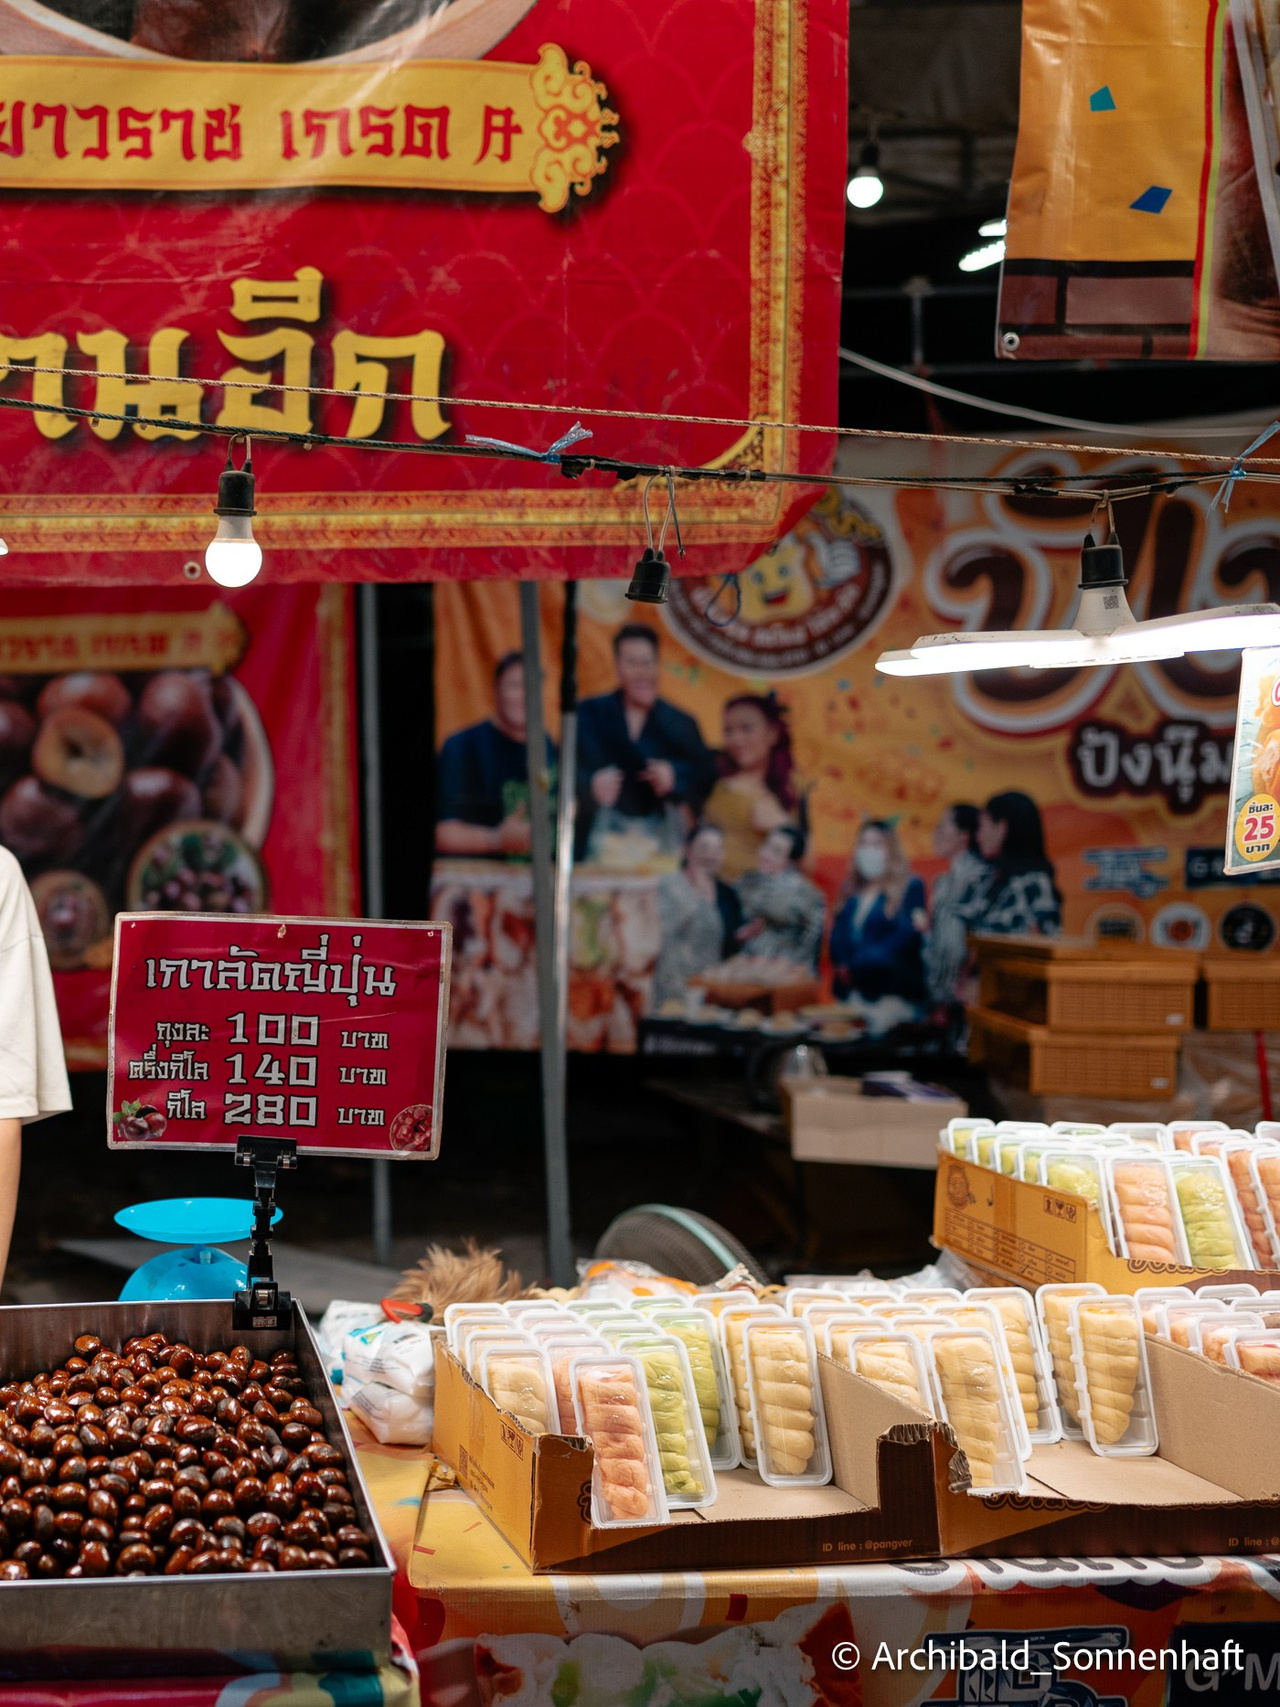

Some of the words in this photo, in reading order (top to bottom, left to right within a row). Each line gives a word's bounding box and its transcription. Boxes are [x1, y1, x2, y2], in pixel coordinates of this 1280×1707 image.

[278, 105, 452, 161] เกรด
[1243, 815, 1275, 842] 25
[1245, 843, 1271, 854] บาท
[146, 933, 397, 1007] เกาลัดญี่ปุ่น
[227, 1012, 320, 1046] 100
[341, 1031, 389, 1050] บาท
[128, 1044, 210, 1081] ครึ่งกิโล
[224, 1053, 318, 1087] 140
[339, 1066, 387, 1085] บาท
[166, 1089, 207, 1120] กิโล
[223, 1092, 318, 1127] 280
[337, 1107, 385, 1126] บาท
[822, 1542, 833, 1552] ID
[838, 1541, 856, 1552] line
[865, 1538, 913, 1551] @pangver
[1228, 1537, 1239, 1547] ID
[1244, 1537, 1263, 1547] line
